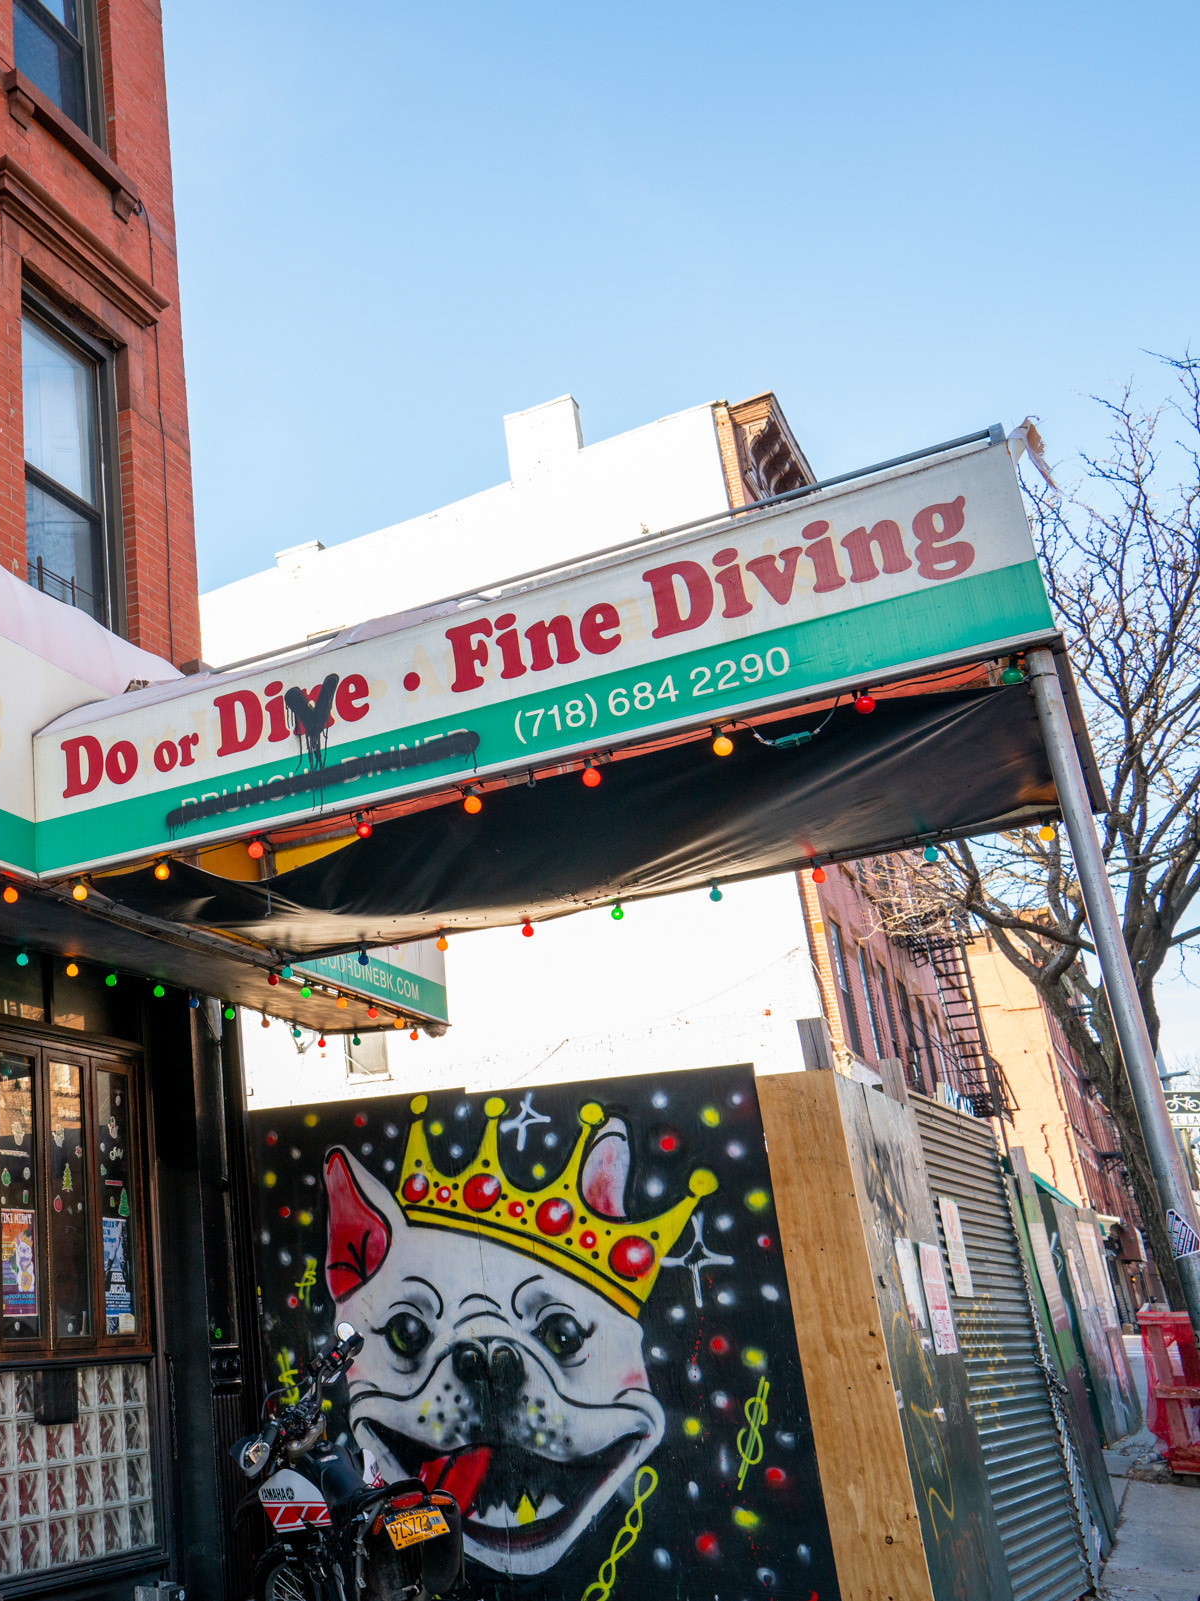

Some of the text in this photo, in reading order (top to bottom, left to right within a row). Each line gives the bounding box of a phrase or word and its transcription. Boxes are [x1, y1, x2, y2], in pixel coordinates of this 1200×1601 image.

[60, 734, 138, 799] Do
[153, 732, 199, 773] or
[445, 601, 622, 693] Fine
[642, 495, 975, 640] Diving
[515, 647, 790, 744] (718) 684 2290
[261, 1487, 288, 1501] YAMAHA
[394, 1508, 429, 1520] NEW YORK
[404, 1529, 440, 1545] EMPIRE STATE
